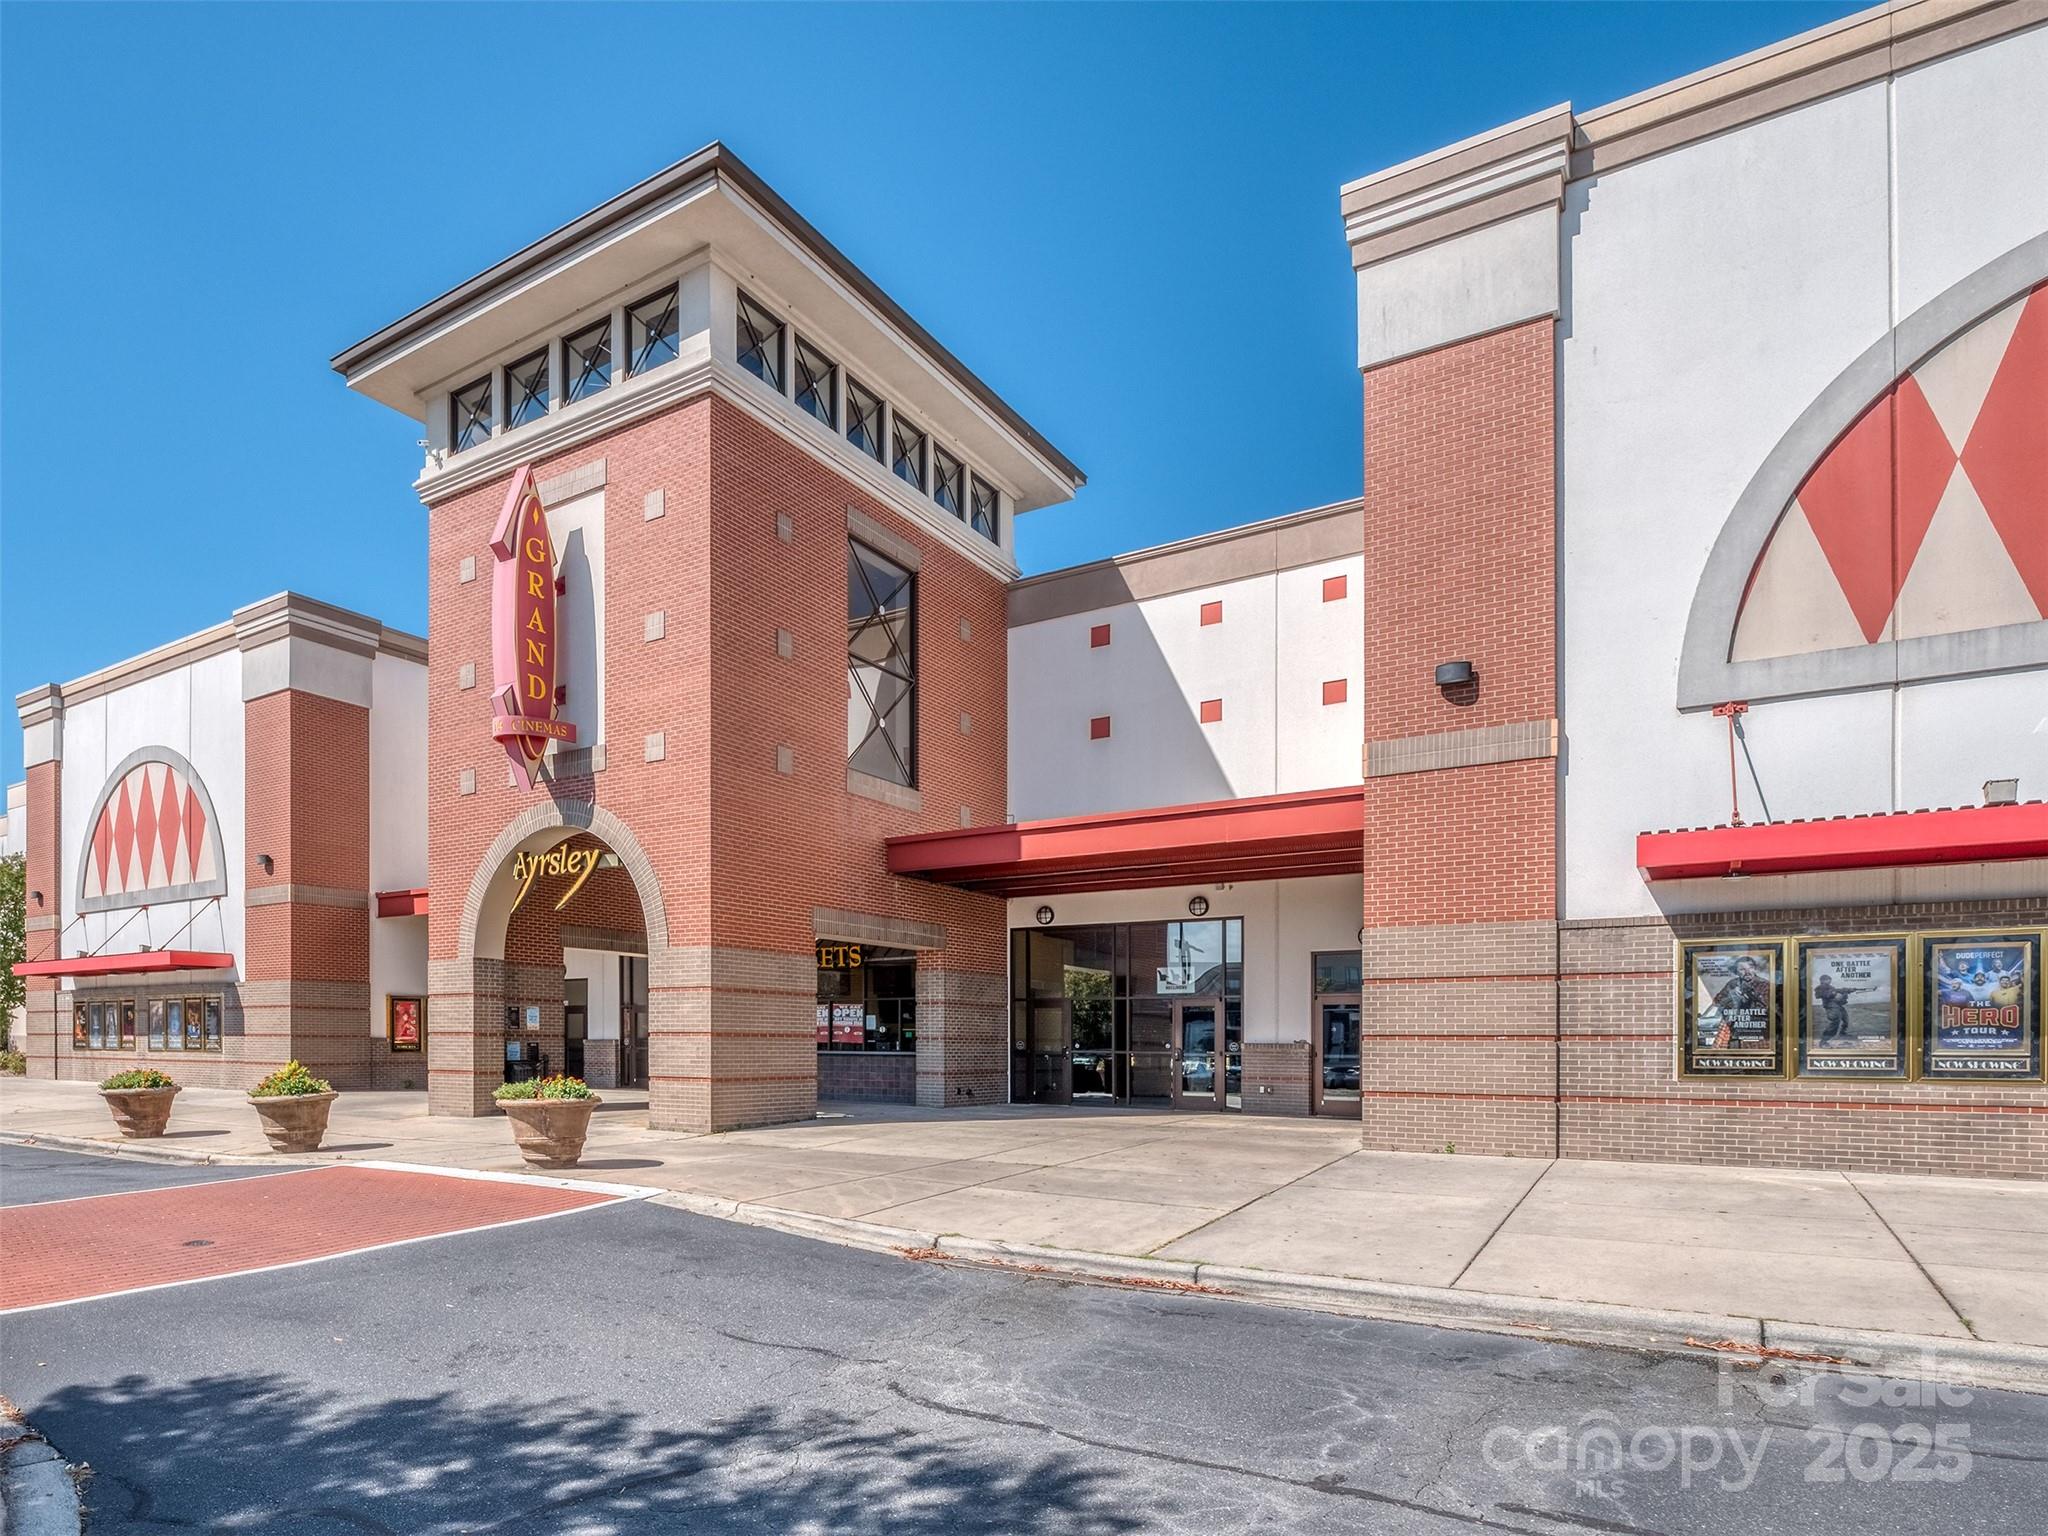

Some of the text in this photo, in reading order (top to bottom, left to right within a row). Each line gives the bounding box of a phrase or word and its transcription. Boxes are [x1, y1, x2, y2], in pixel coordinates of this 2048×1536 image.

[525, 537, 546, 700] GRAND
[511, 720, 568, 736] CINEMAS
[510, 843, 600, 914] Ayrsley
[816, 945, 862, 968] ETS
[833, 1008, 863, 1017] OPEN
[1723, 1008, 1767, 1016] ONE BATTLE
[1941, 1004, 2020, 1029] HERO
[1733, 1021, 1767, 1029] ANOTHER
[1963, 1027, 1997, 1035] TOUR
[1699, 1059, 1768, 1067] NOW SHOWING
[1840, 1060, 1888, 1068] SHOWING
[1938, 1060, 2020, 1069] NOW SHOWING
